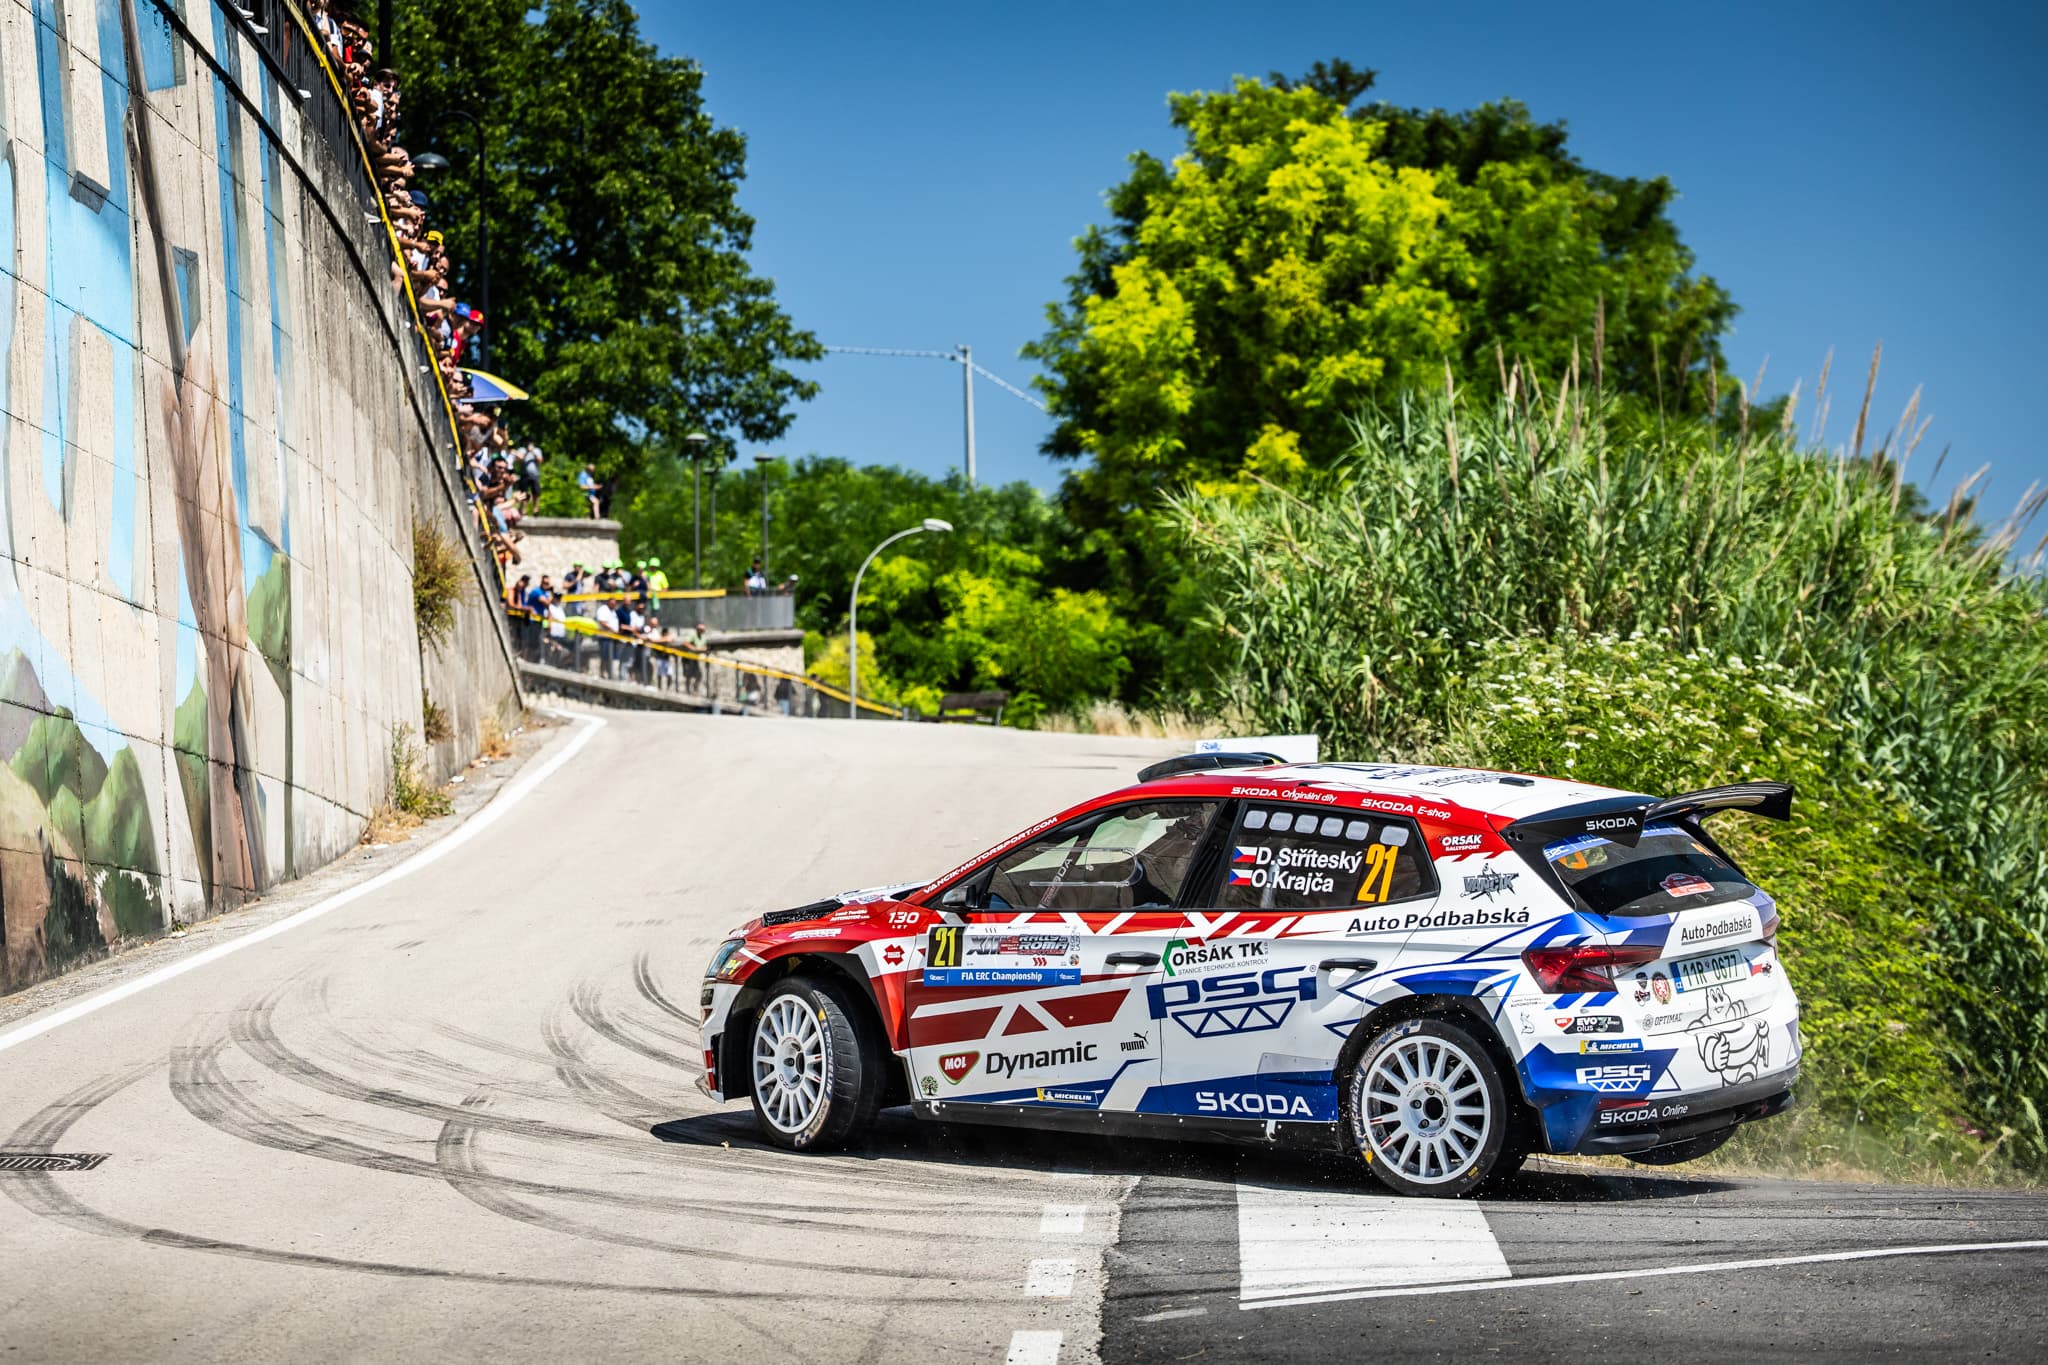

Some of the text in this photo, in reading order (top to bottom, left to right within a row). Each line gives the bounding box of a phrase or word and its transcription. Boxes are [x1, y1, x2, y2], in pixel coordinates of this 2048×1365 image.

[1417, 806, 1451, 820] E-shop
[1357, 843, 1398, 903] 21
[888, 911, 920, 924] 130
[1347, 907, 1530, 932] Auto Podbabská
[1681, 914, 1752, 941] Auto Podbabská
[934, 927, 957, 966] 21
[1239, 941, 1264, 957] TK
[1178, 968, 1202, 976] STANICE
[1237, 959, 1269, 968] KONTROLY
[1712, 954, 1738, 980] 0677
[961, 972, 1042, 983] FIA ERC Championship
[1120, 1040, 1146, 1052] PUMA
[1600, 1042, 1639, 1050] MICHELIN
[945, 1041, 1098, 1079] MOL Dynamic
[1054, 1093, 1092, 1101] MICHELIN
[1662, 1104, 1689, 1117] Online
